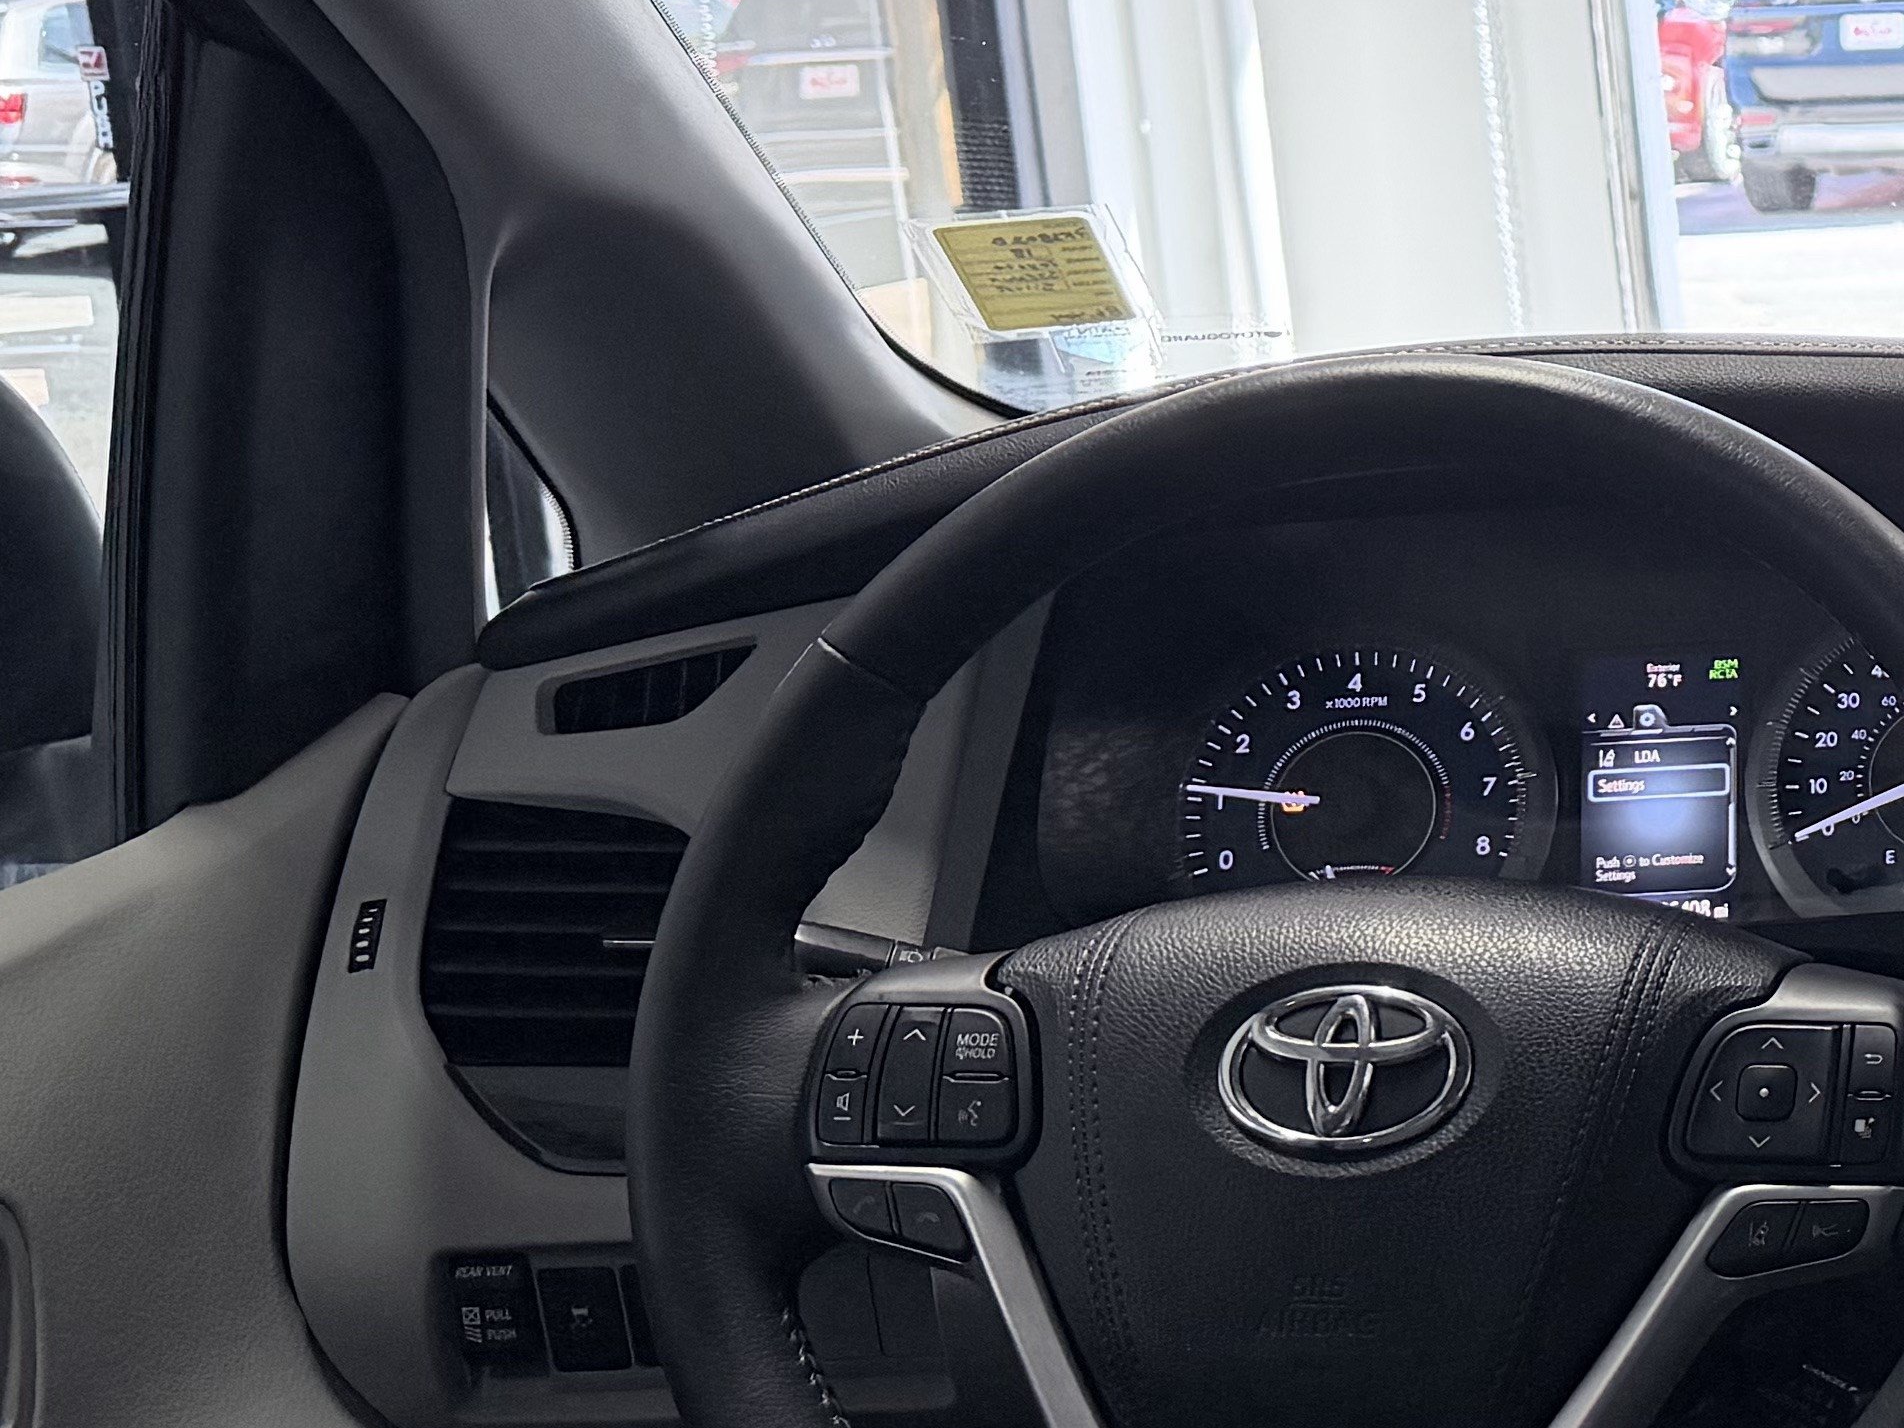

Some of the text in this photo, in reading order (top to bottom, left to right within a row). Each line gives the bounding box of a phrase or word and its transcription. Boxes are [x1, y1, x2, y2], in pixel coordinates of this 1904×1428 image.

[1348, 673, 1362, 692] 4
[1286, 690, 1301, 710] 3
[1413, 683, 1426, 703] 5
[1837, 692, 1860, 709] 30
[1881, 695, 1897, 707] 60
[1326, 695, 1388, 709] x1000 RPM
[1460, 721, 1475, 741] 6
[1851, 729, 1867, 740] 40
[1236, 734, 1250, 754] 2
[1815, 731, 1838, 748] 20
[1634, 749, 1661, 764] LDA
[1839, 770, 1855, 781] 20
[1483, 777, 1497, 796] 7
[1597, 778, 1646, 795] Settings
[1809, 778, 1828, 794] 10
[1476, 836, 1490, 855] 8
[1218, 849, 1234, 870] 0
[1595, 853, 1705, 869] Push to Customize
[1885, 849, 1896, 864] E
[1595, 869, 1636, 883] Settings
[955, 1033, 999, 1047] MODE
[485, 1308, 512, 1323] PULL
[1256, 1310, 1381, 1339] AIRBAG
[487, 1329, 517, 1341] PUSH
